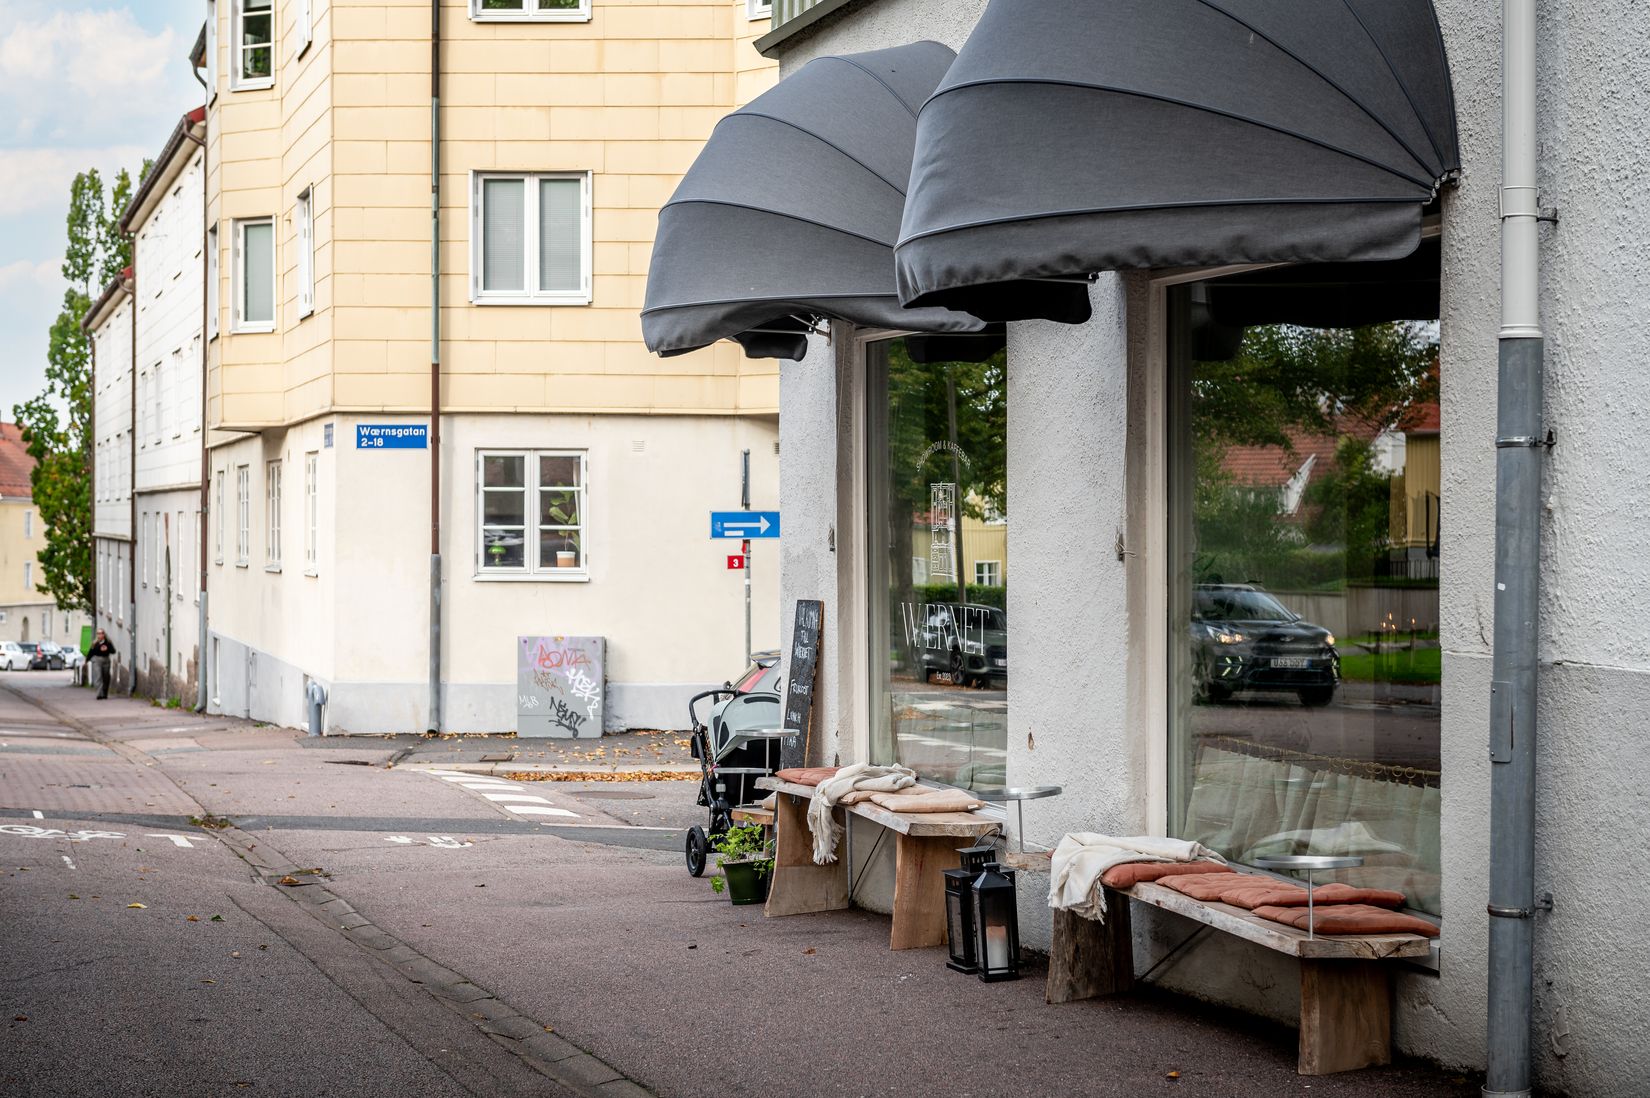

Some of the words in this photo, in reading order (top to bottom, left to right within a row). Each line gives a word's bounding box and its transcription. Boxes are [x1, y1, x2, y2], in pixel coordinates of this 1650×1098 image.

[359, 427, 425, 438] Wærnsgatan
[361, 438, 384, 447] 2-18
[947, 440, 971, 470] KAFFEBAR
[732, 558, 739, 567] 3
